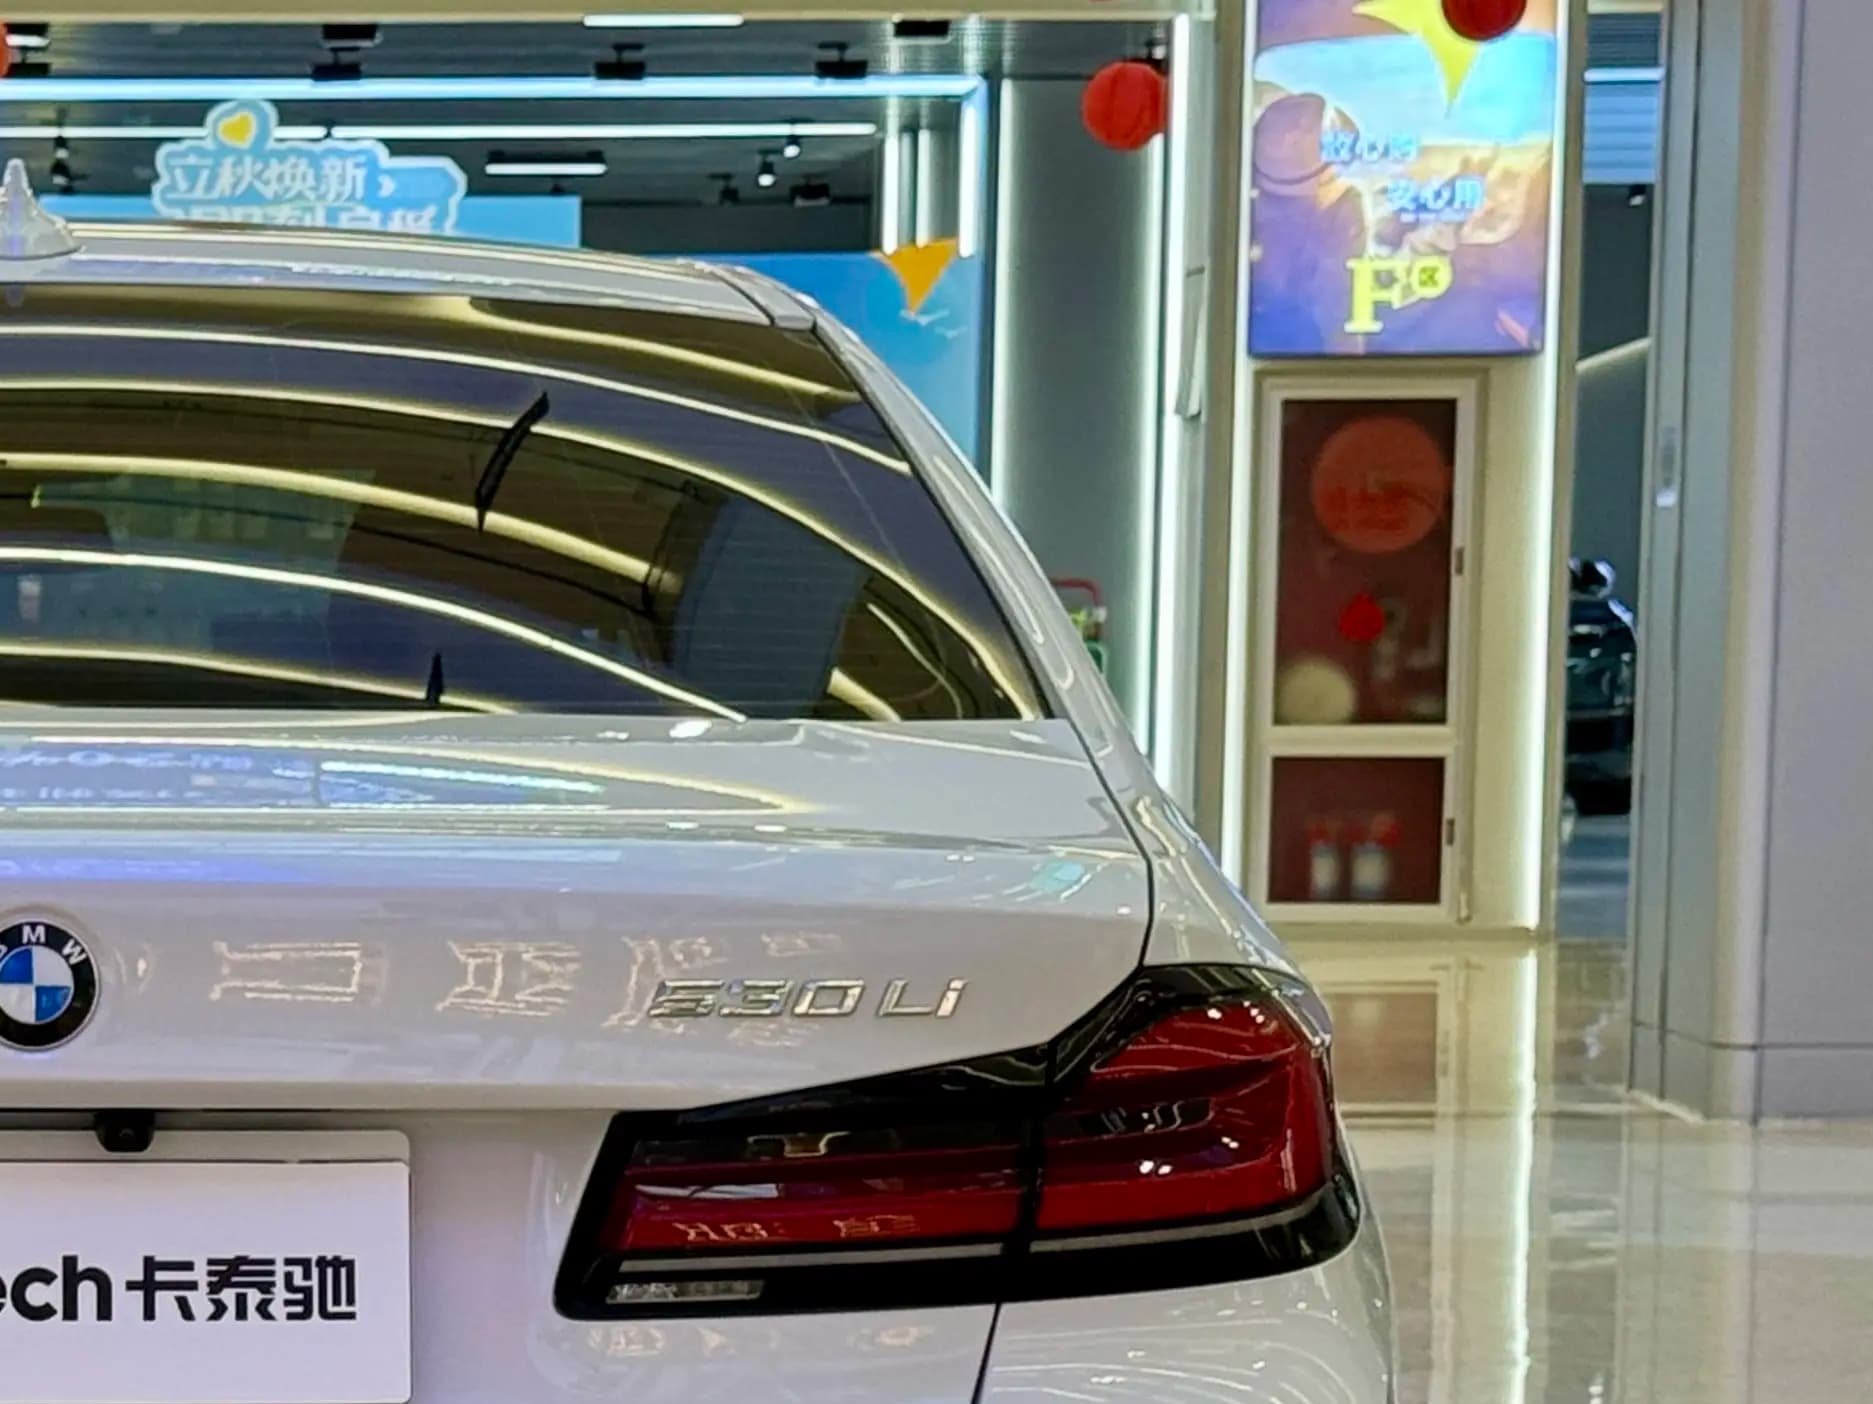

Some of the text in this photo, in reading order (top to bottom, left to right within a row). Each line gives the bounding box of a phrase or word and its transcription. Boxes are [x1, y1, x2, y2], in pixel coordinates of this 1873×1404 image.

[166, 153, 368, 203] 立秋焕新
[126, 1254, 358, 1323] 卡泰驰
